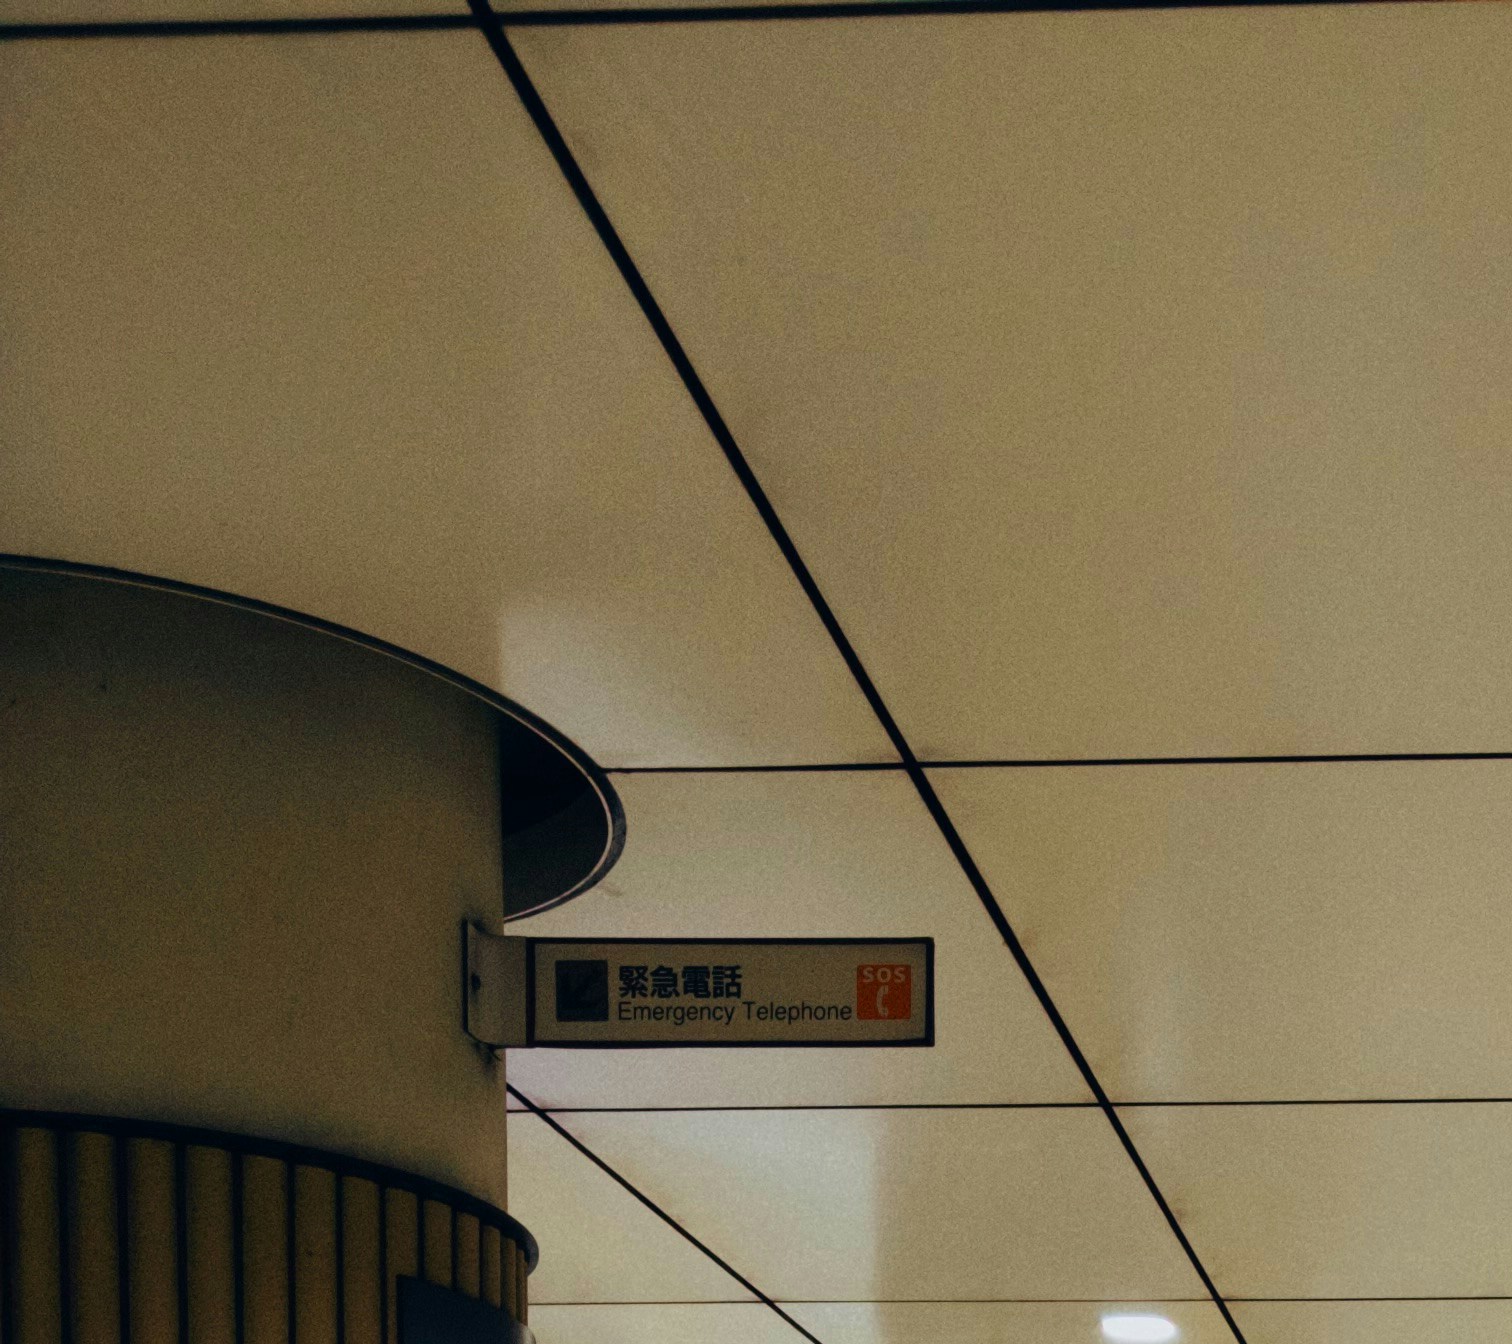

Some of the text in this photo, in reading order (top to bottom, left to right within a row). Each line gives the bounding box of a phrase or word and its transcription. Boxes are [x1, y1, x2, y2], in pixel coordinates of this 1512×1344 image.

[618, 965, 742, 999] 緊急電話
[863, 967, 906, 983] SOS
[618, 1002, 852, 1025] Emergency Telephone
